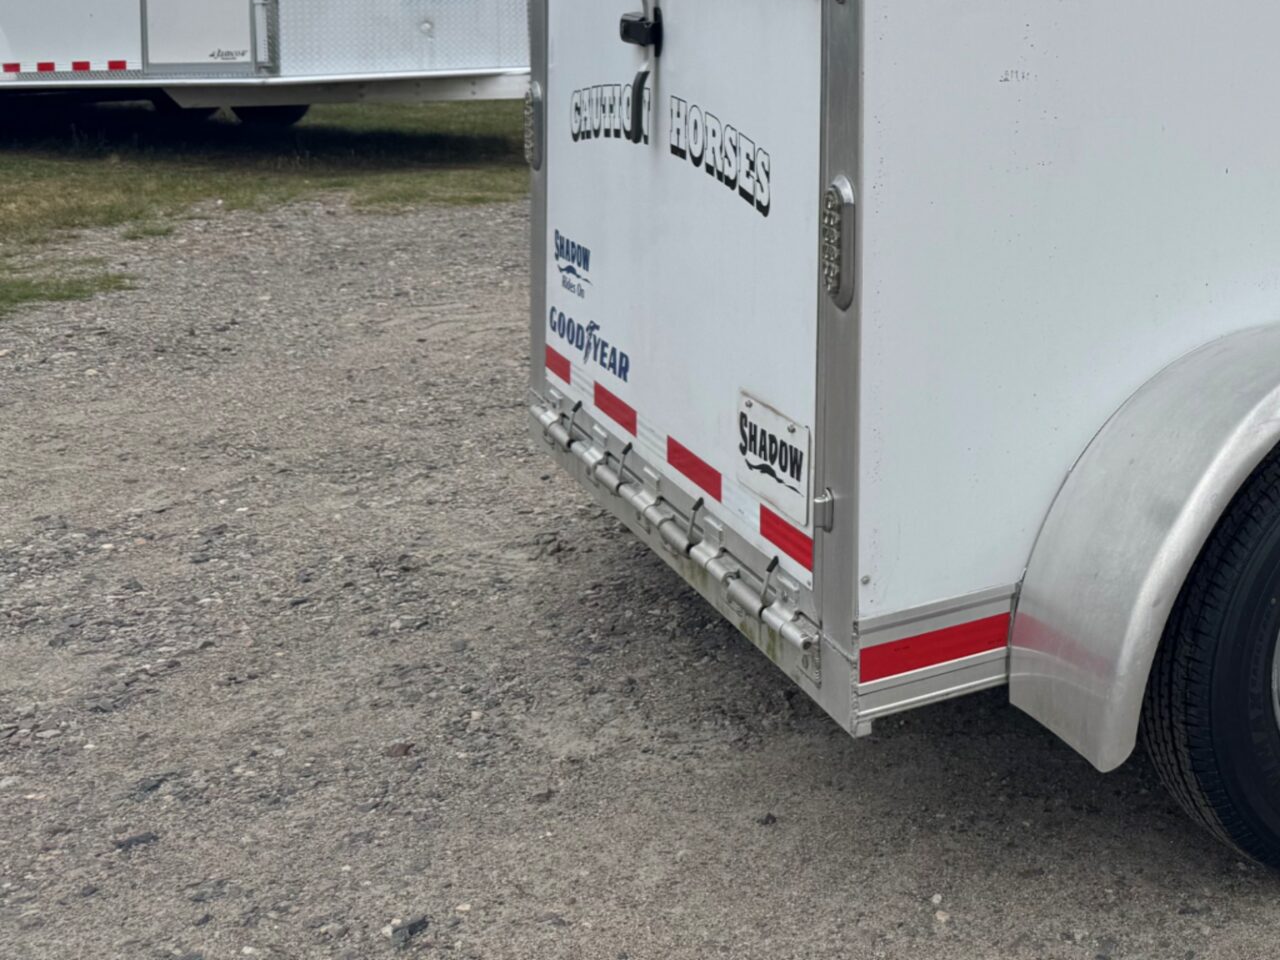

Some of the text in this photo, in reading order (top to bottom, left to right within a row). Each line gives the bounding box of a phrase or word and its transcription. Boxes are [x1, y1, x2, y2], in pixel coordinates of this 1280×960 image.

[669, 94, 771, 218] HORSES
[554, 228, 591, 273] SHADOW
[549, 305, 630, 383] GOODYEAR
[738, 411, 804, 482] SHADOW
